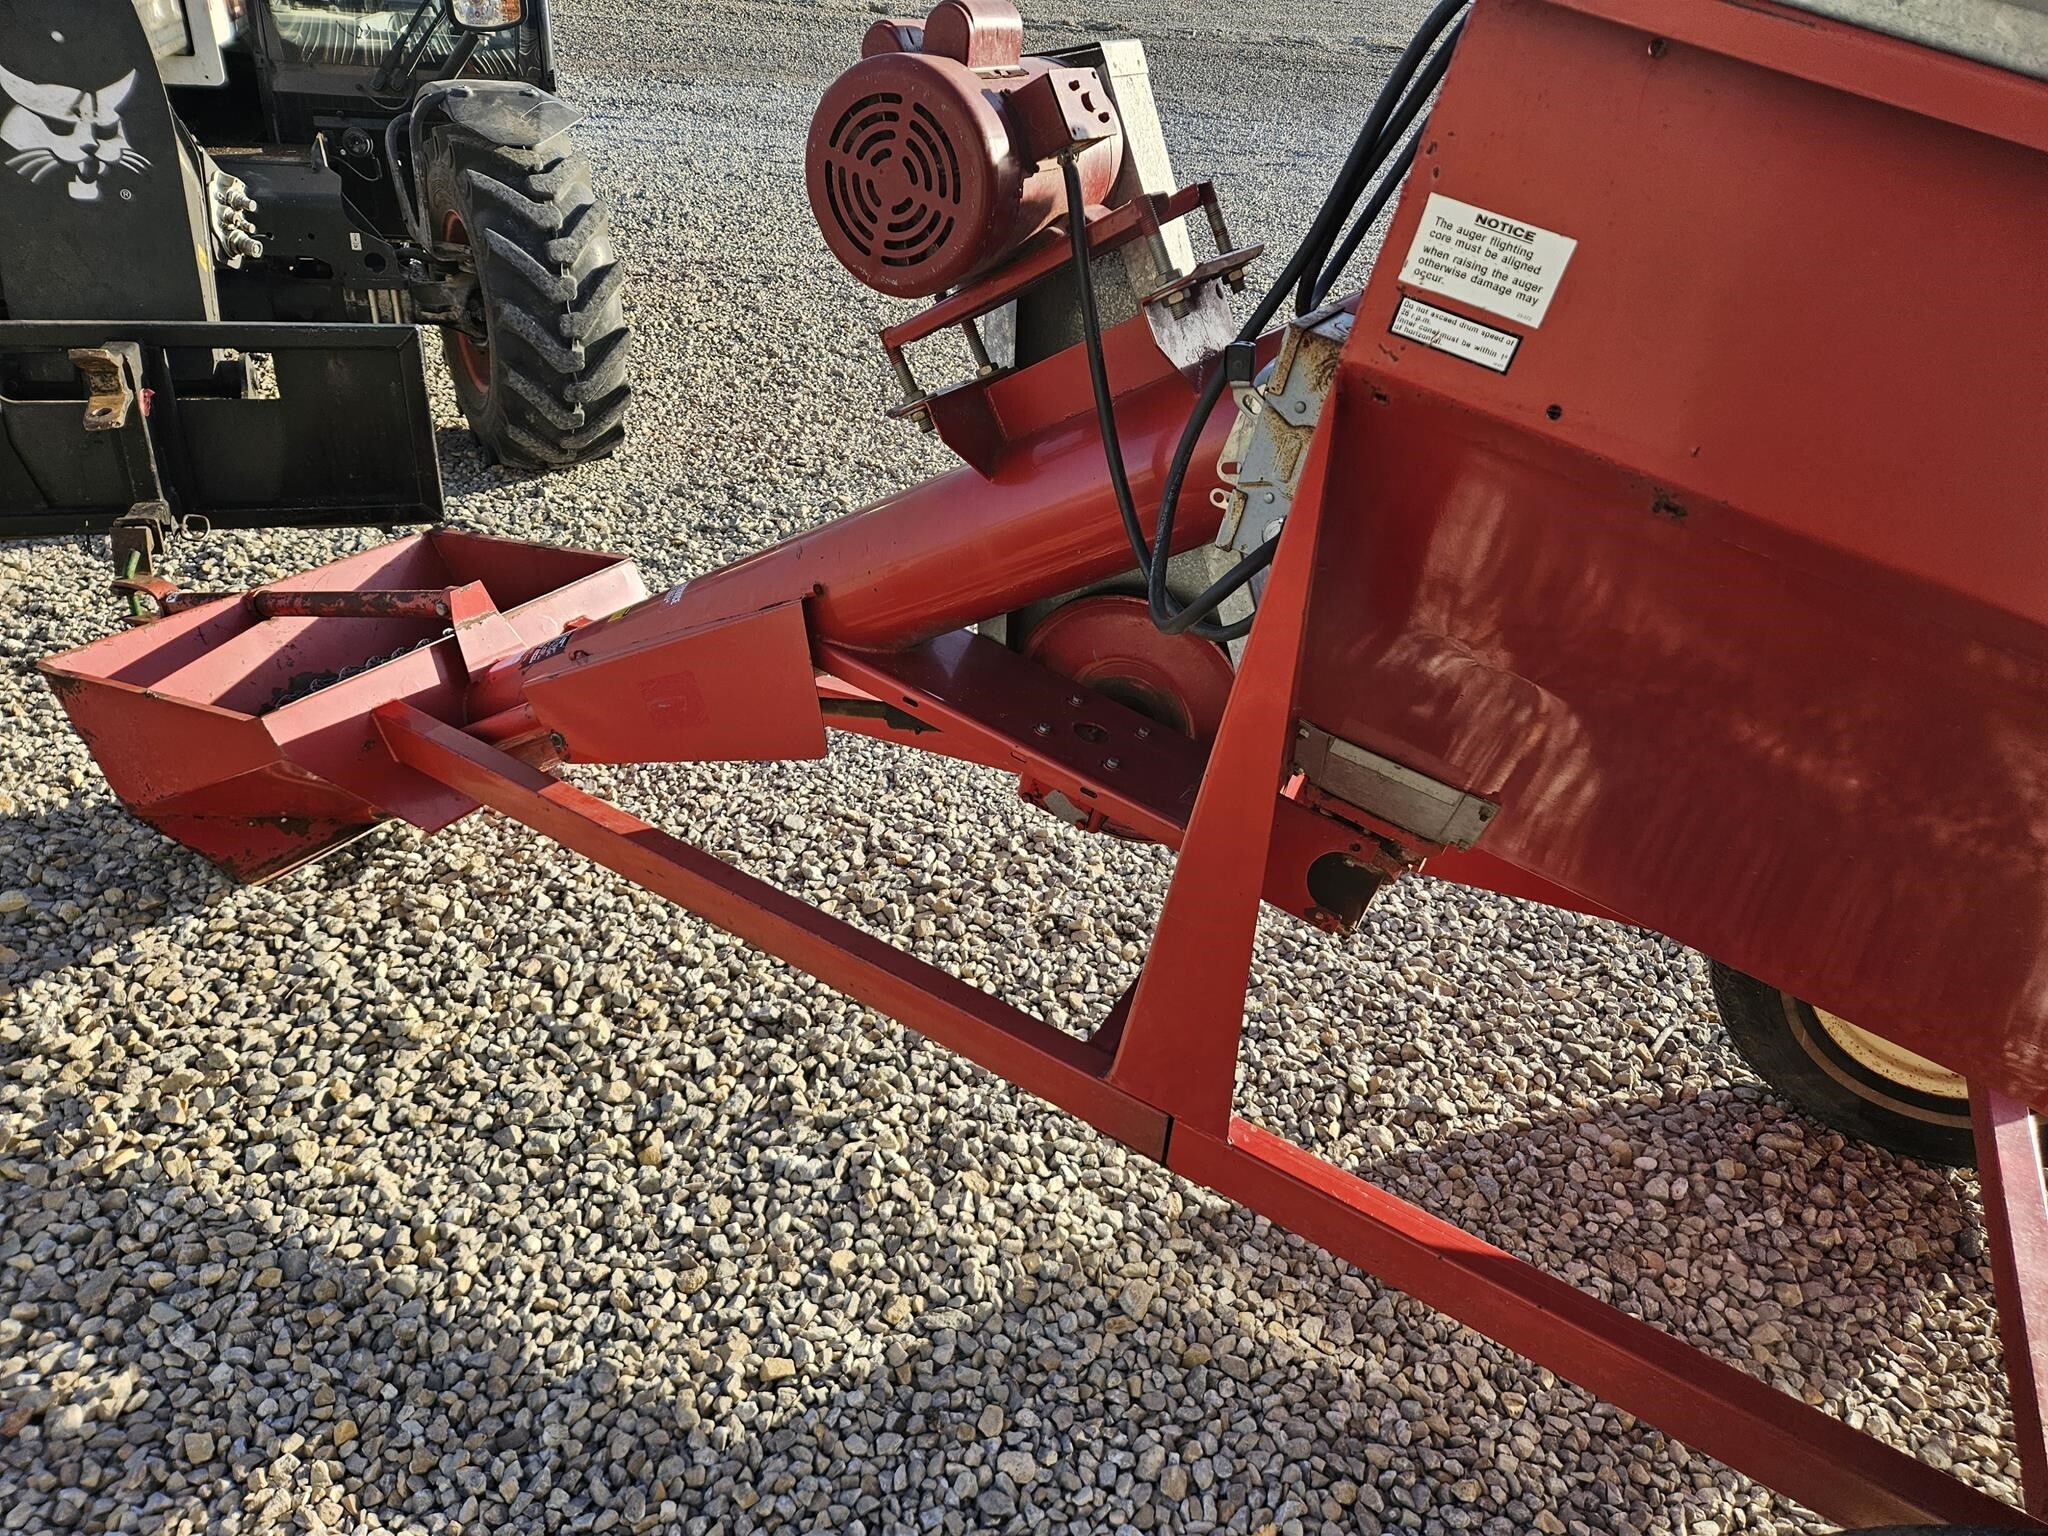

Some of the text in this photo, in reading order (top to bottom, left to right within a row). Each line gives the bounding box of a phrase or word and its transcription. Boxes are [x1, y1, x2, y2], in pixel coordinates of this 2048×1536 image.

[1435, 215, 1534, 261] The auger flighting
[1475, 213, 1537, 242] NOTICE
[1423, 245, 1544, 293] when raising the auger
[1430, 230, 1542, 275] core must be aligned
[1413, 268, 1444, 285] occur.
[1418, 256, 1540, 307] otherwise damage may
[1403, 300, 1515, 346] Do not exceed drum speed of
[1410, 313, 1432, 325] r.p.m.
[1439, 332, 1460, 344] must
[1461, 339, 1471, 348] be
[1474, 344, 1498, 358] within
